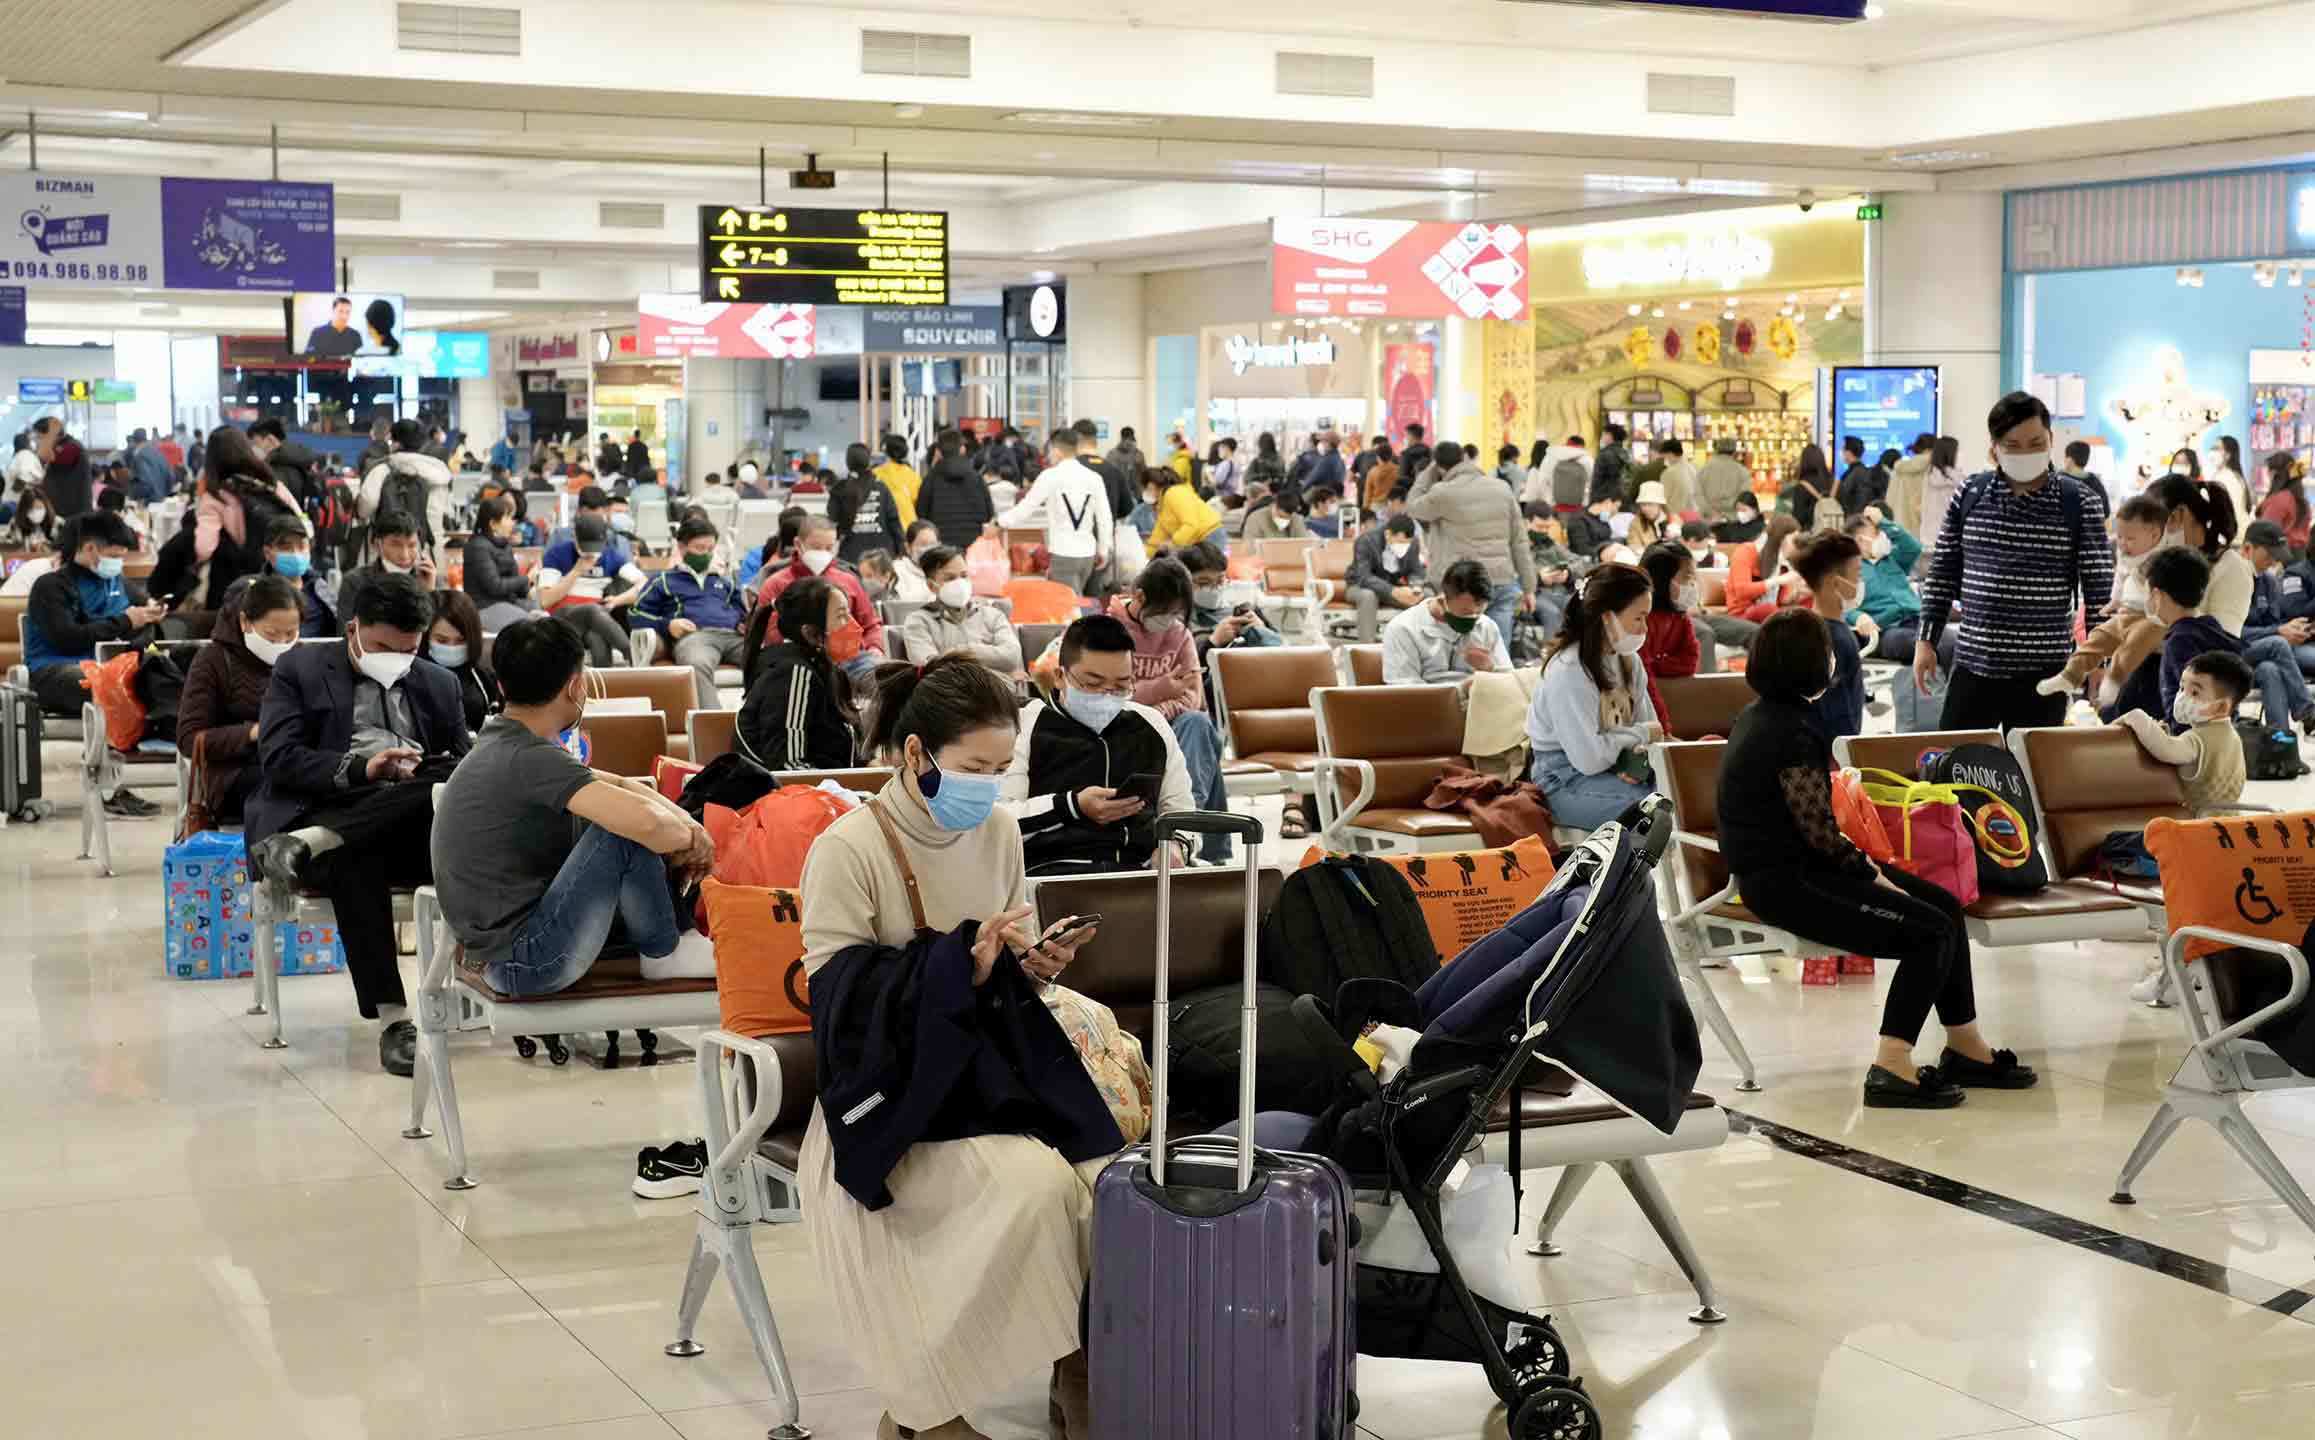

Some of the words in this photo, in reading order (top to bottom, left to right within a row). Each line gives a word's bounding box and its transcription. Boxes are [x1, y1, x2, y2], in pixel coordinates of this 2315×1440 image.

[35, 179, 94, 193] BIZMAN
[1311, 229, 1373, 247] SHG
[14, 262, 148, 281] 094.986.98.98
[903, 328, 997, 345] SOUVENIR
[1062, 493, 1090, 531] V
[1462, 887, 1488, 897] SEAT
[1404, 1093, 1427, 1110] Combi
